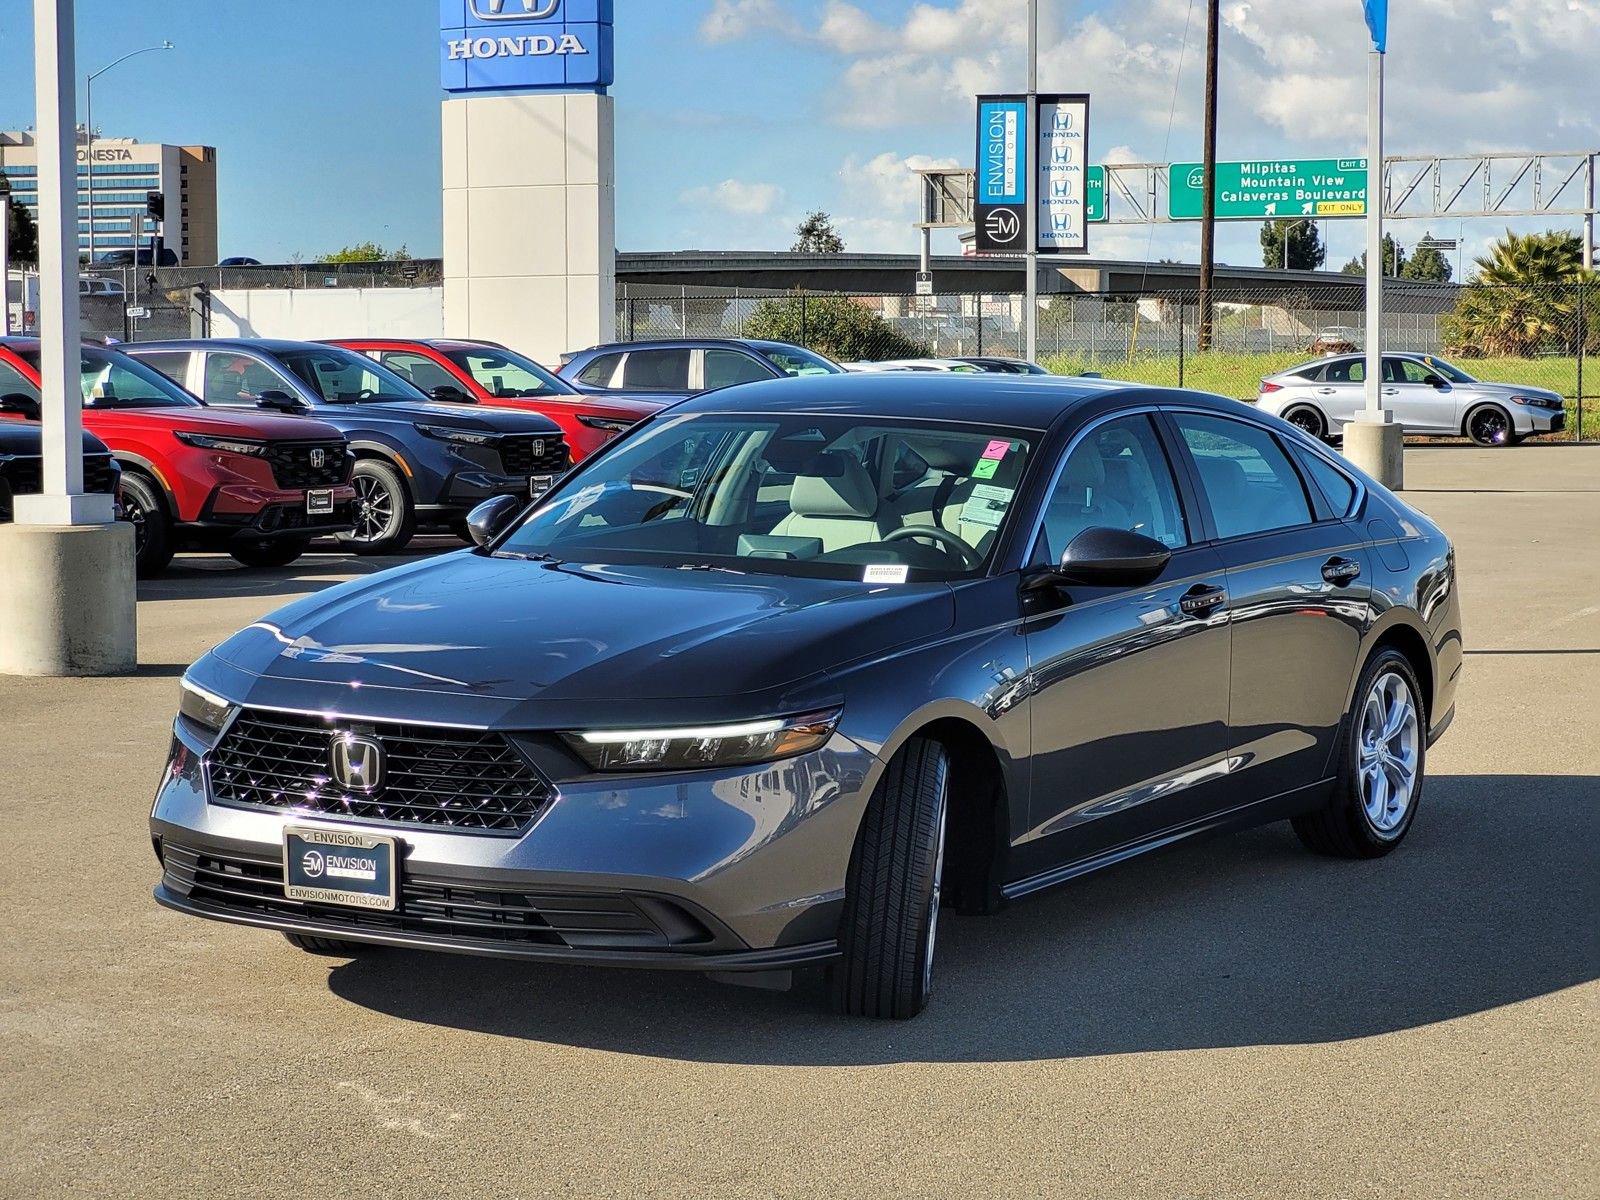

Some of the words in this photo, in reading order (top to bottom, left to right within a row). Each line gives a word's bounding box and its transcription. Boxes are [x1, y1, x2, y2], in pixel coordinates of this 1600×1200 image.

[448, 35, 588, 60] HONDA
[988, 111, 1004, 196] ENVISION
[1241, 163, 1296, 176] Milpitas
[1241, 176, 1305, 188] Mountain
[1312, 176, 1344, 186] View
[1221, 190, 1289, 202] Calaveras
[1295, 188, 1366, 201] Boulevard
[1318, 204, 1335, 212] EXIT
[1340, 203, 1363, 211] ONLY
[314, 832, 363, 846] ENVISION
[326, 855, 376, 871] ENVISION
[290, 888, 390, 908] ENVISIONMOTORS.COM
